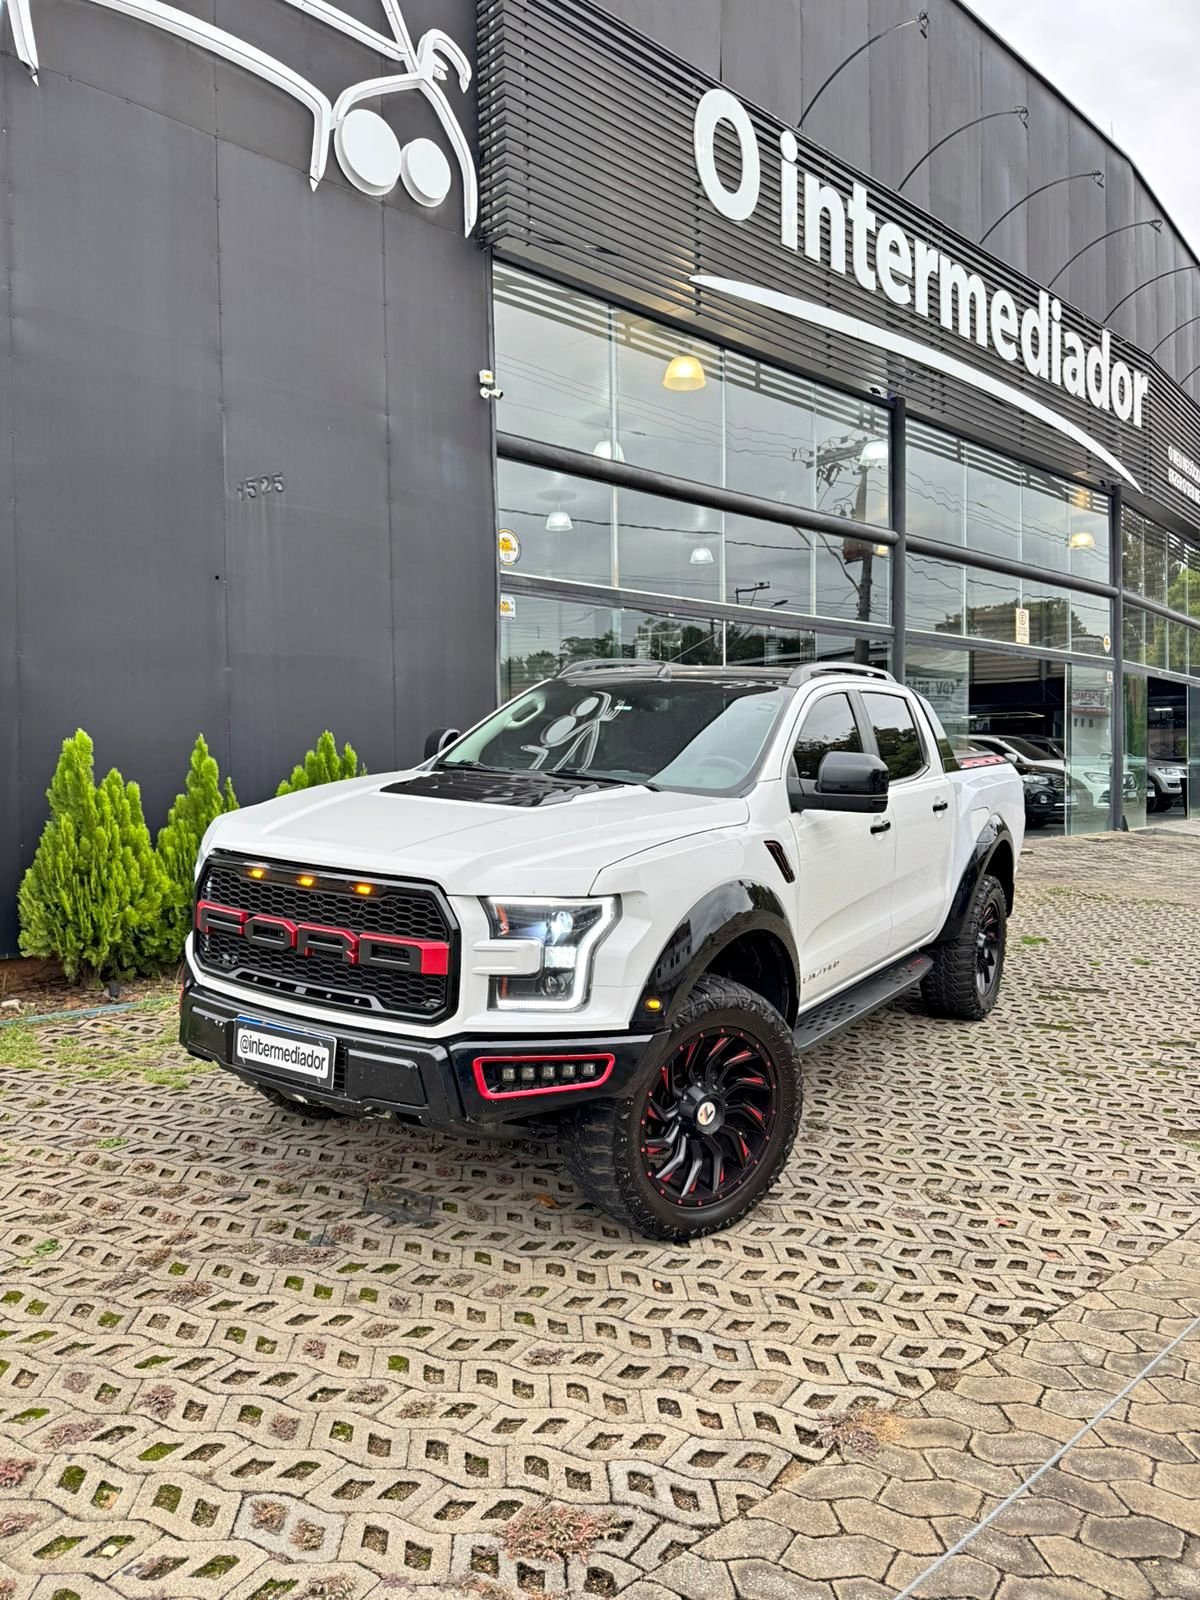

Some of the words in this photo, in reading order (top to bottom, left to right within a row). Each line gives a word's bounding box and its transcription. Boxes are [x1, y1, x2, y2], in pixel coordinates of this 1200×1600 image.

[694, 88, 760, 221] O
[779, 130, 1148, 428] intermediador
[237, 473, 284, 501] 1525
[197, 900, 449, 976] FORD
[239, 1034, 326, 1071] @intermediador
